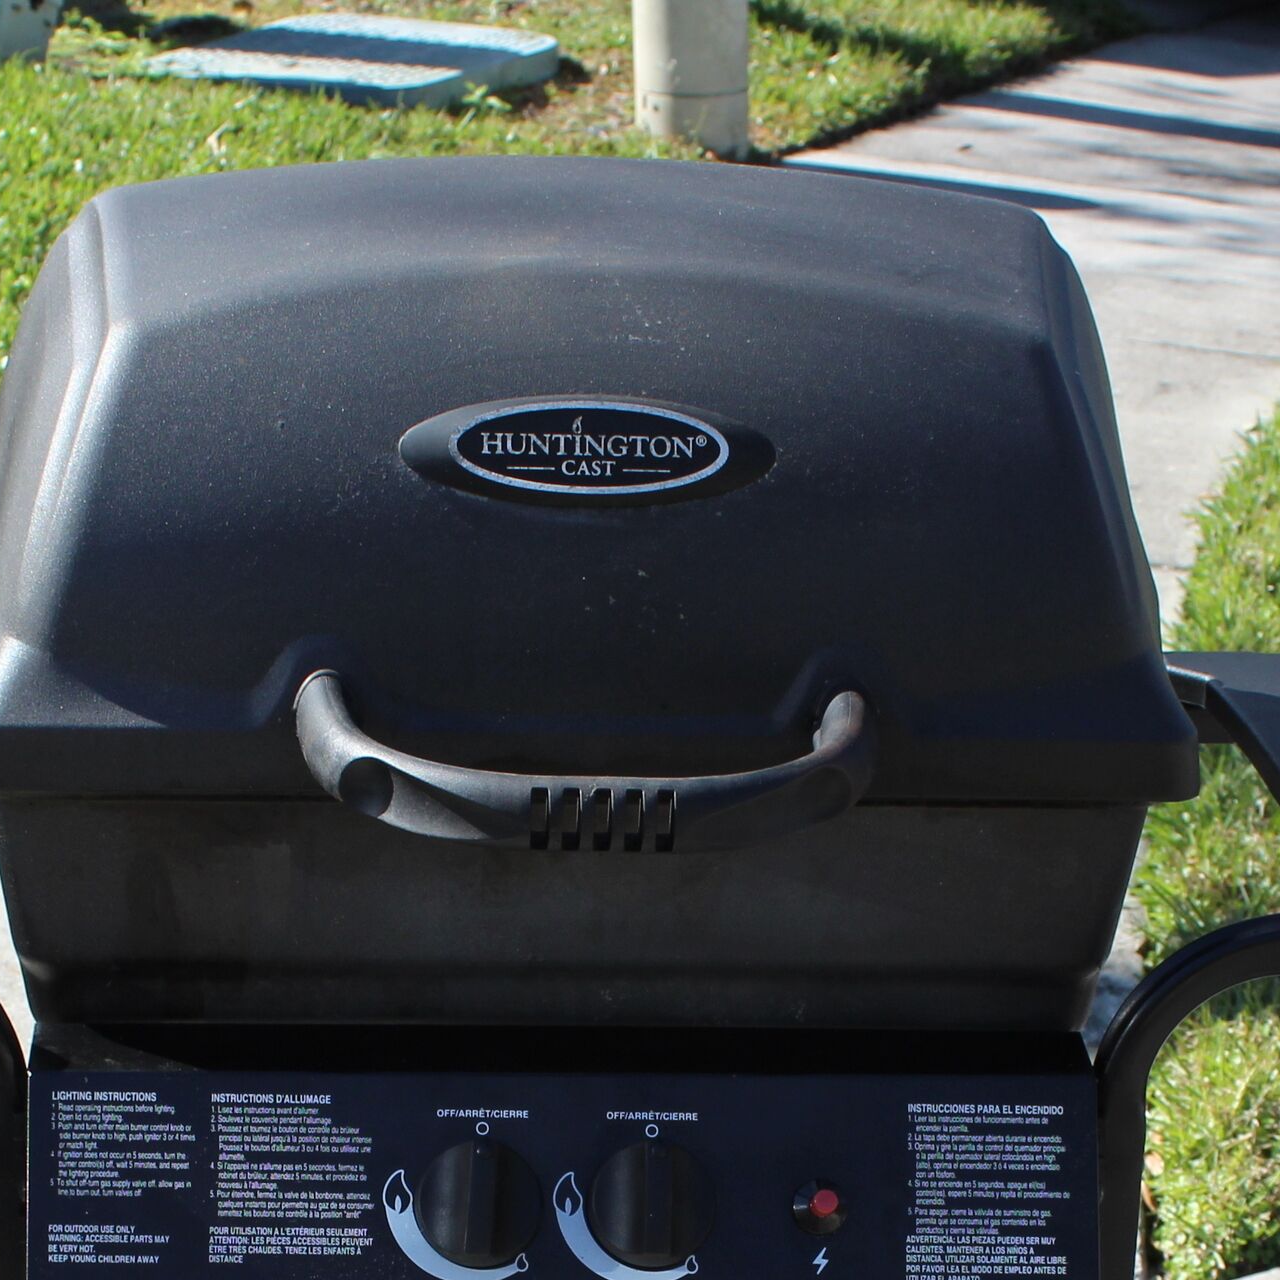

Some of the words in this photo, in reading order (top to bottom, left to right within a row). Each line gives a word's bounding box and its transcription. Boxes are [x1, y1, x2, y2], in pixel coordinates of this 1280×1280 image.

[561, 460, 616, 476] CAST
[52, 1092, 92, 1100] LIGHTING
[94, 1092, 156, 1101] INSTRUCTIONS
[212, 1094, 274, 1103] INSTRUCTIONS
[276, 1094, 331, 1104] D'ALLUMAGE
[437, 1108, 528, 1118] OFF/ARRÊT/CIERRE
[908, 1104, 975, 1113] INSTRUCCIONES
[978, 1105, 1000, 1114] PARA
[1003, 1105, 1013, 1114] EL
[1015, 1105, 1063, 1114] ENCENDIDO
[607, 1110, 698, 1120] OFF/ARRÊT/CIERRE
[64, 1225, 99, 1233] OUTDOOR
[101, 1225, 114, 1233] USE
[326, 1228, 367, 1236] SEULEMENT
[130, 1235, 153, 1243] PARTS
[342, 1238, 373, 1246] PEUVENT
[957, 1236, 970, 1244] LAS
[972, 1236, 996, 1244] PIEZAS
[1041, 1237, 1056, 1245] MUY
[324, 1247, 355, 1255] ENFANTS
[947, 1246, 983, 1254] MANTENER
[985, 1246, 990, 1254] A
[992, 1246, 1005, 1254] LOS
[98, 1255, 135, 1263] CHILDREN
[209, 1255, 243, 1263] DISTANCE
[945, 1255, 974, 1263] UTILIZAR
[1019, 1256, 1028, 1264] AL
[1029, 1256, 1045, 1264] AIRE
[906, 1265, 920, 1273] POR
[972, 1266, 992, 1274] MODO
[994, 1266, 1003, 1274] DE
[1005, 1266, 1032, 1274] EMPLEO
